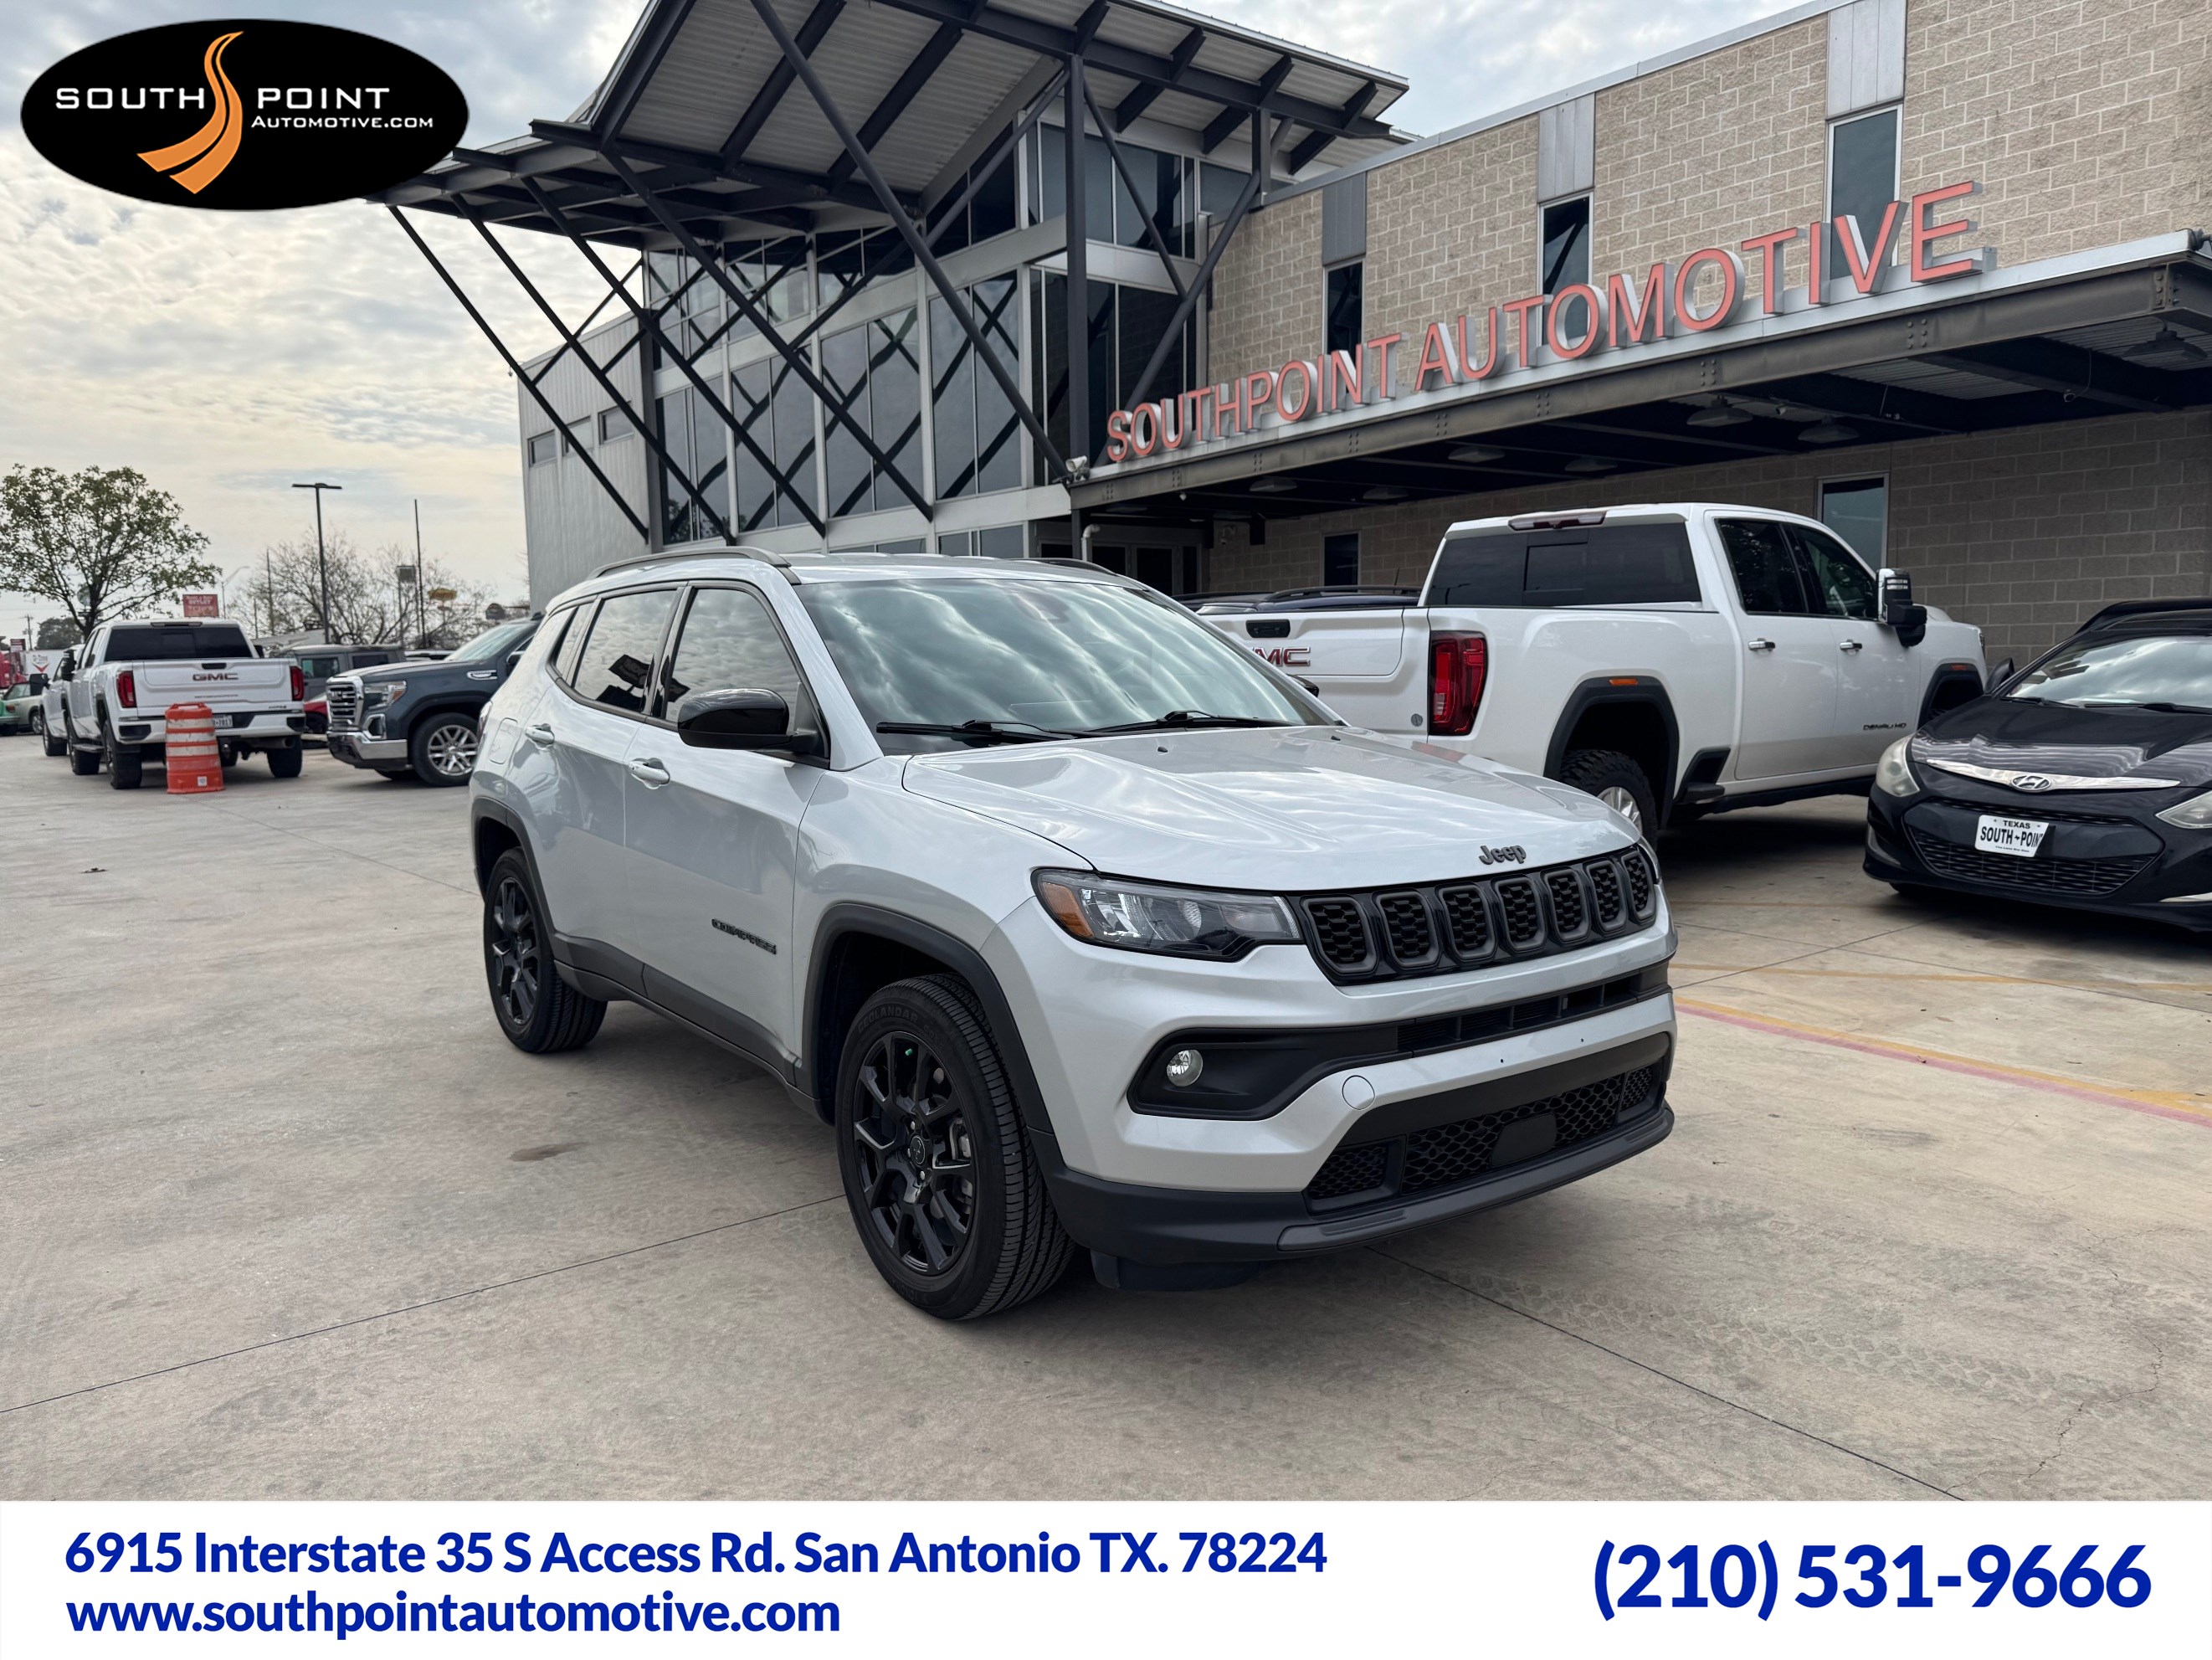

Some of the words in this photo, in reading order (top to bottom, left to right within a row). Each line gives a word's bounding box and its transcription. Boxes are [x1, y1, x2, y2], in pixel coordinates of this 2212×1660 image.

[1106, 333, 1401, 461] SOUTHPOINT
[1414, 181, 1978, 392] AUTOMOTIVE
[1252, 646, 1311, 667] MC
[192, 673, 239, 681] GMC
[1980, 825, 2014, 845] SOUTH
[2003, 820, 2030, 830] TEXAS
[1478, 845, 1527, 866] Jeep
[711, 918, 777, 955] COMPASS
[857, 1005, 919, 1034] GEOLANDAR
